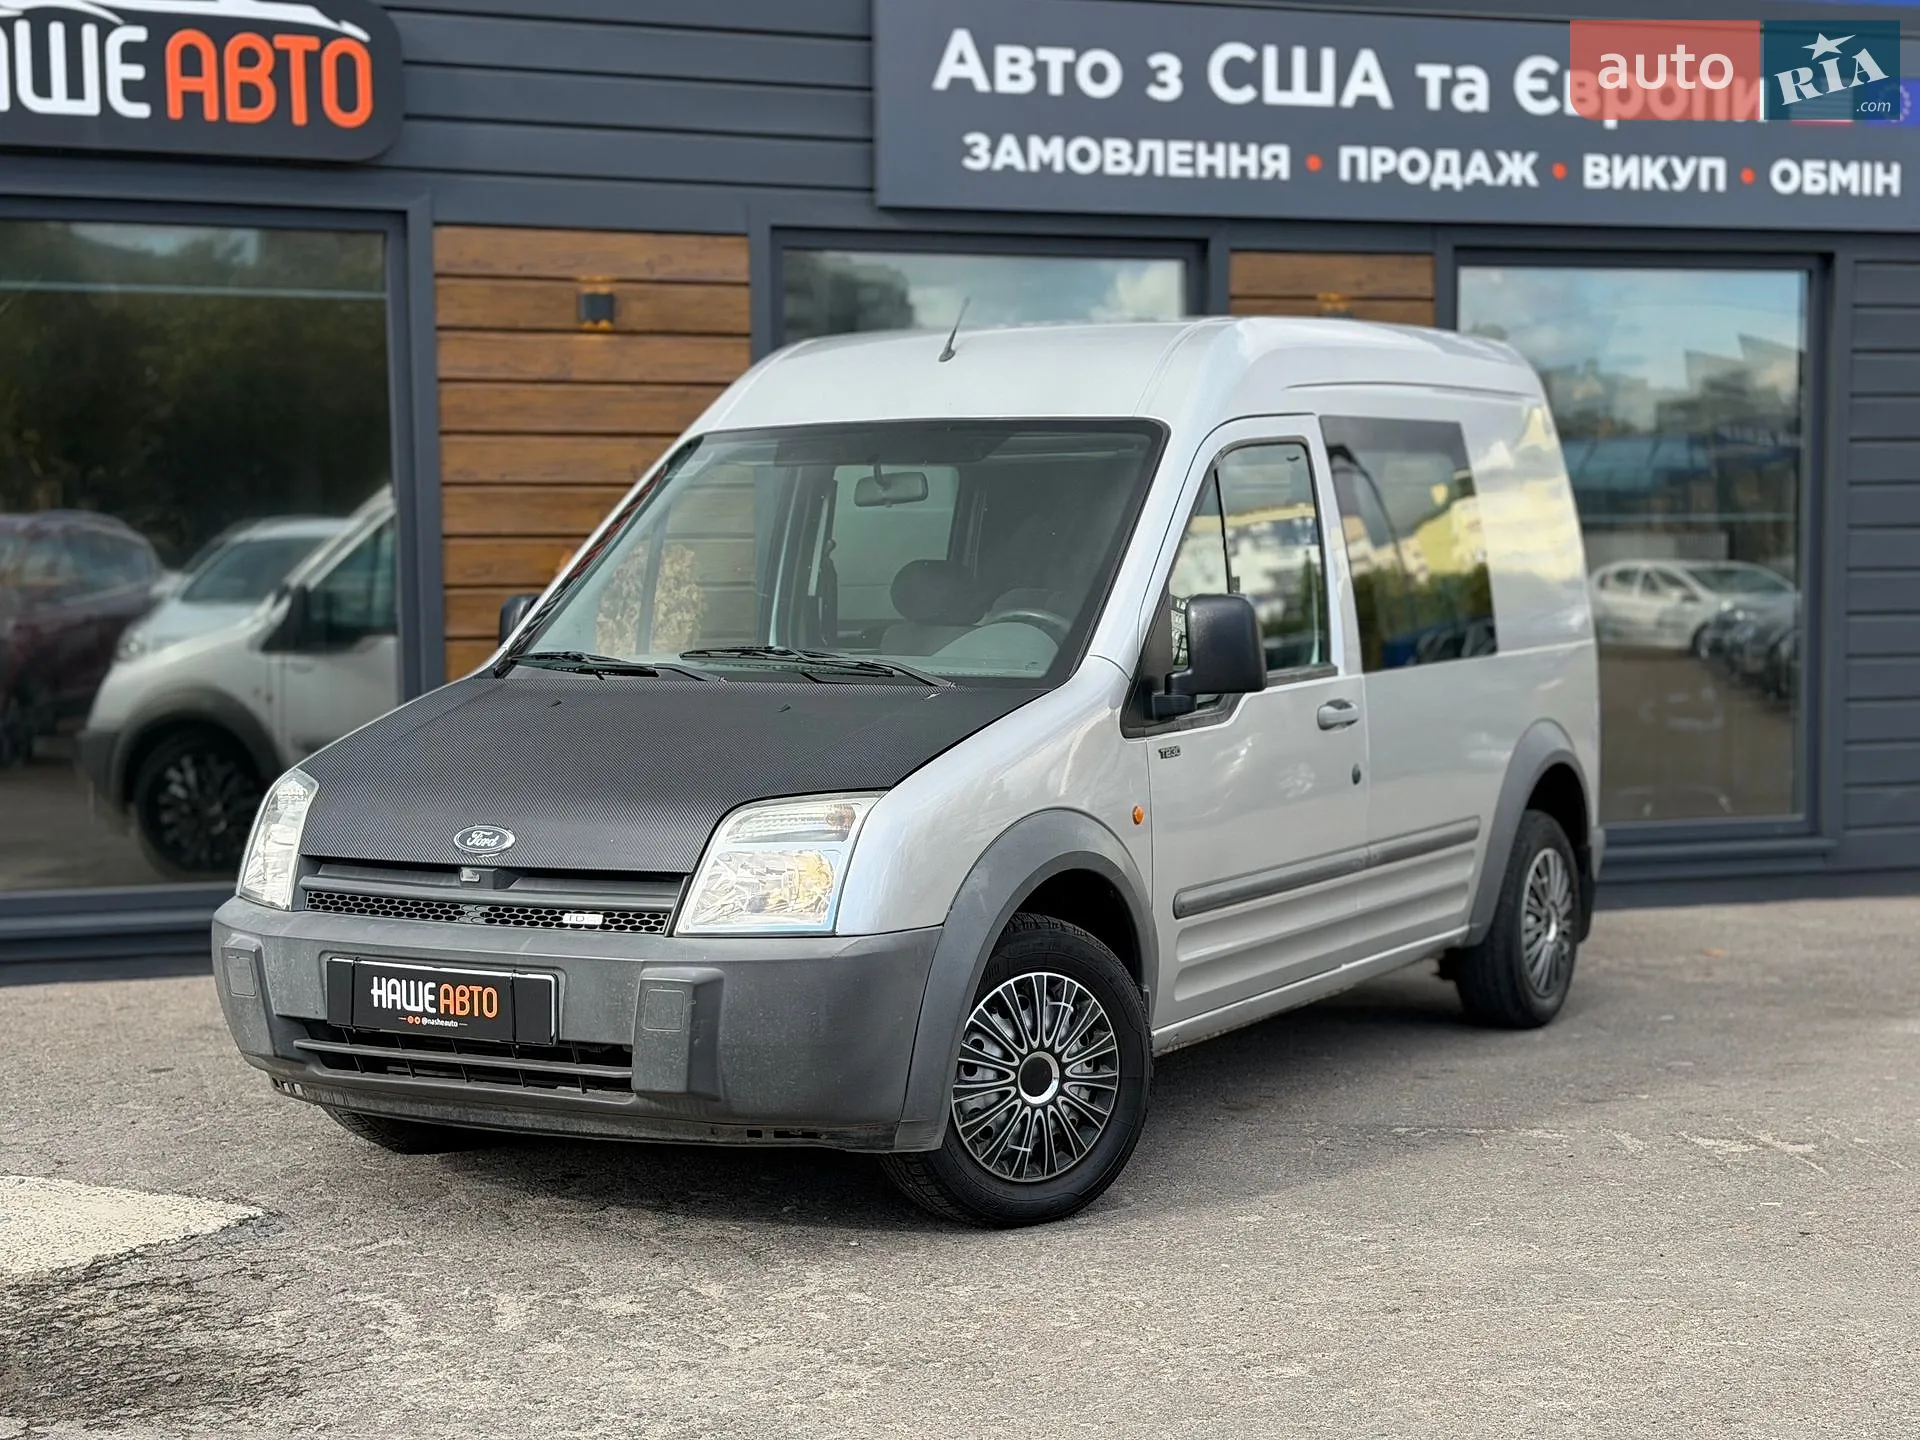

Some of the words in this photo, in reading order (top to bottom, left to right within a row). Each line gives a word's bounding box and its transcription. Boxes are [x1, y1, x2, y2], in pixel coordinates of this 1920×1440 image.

[0, 20, 152, 119] ШЕ
[165, 28, 374, 128] АВТО
[931, 28, 1123, 99] Авто
[1145, 52, 1184, 102] з
[1207, 41, 1394, 109] США
[1415, 62, 1490, 113] та
[961, 131, 1292, 181] ЗАМОВЛЕННЯ
[1338, 144, 1539, 192] ПРОДАЖ
[1583, 152, 1727, 193] ВИКУП
[1769, 158, 1902, 198] ОБМІН
[466, 830, 500, 847] Ford
[370, 976, 437, 1013] НАШЕ
[439, 983, 498, 1018] АВТО
